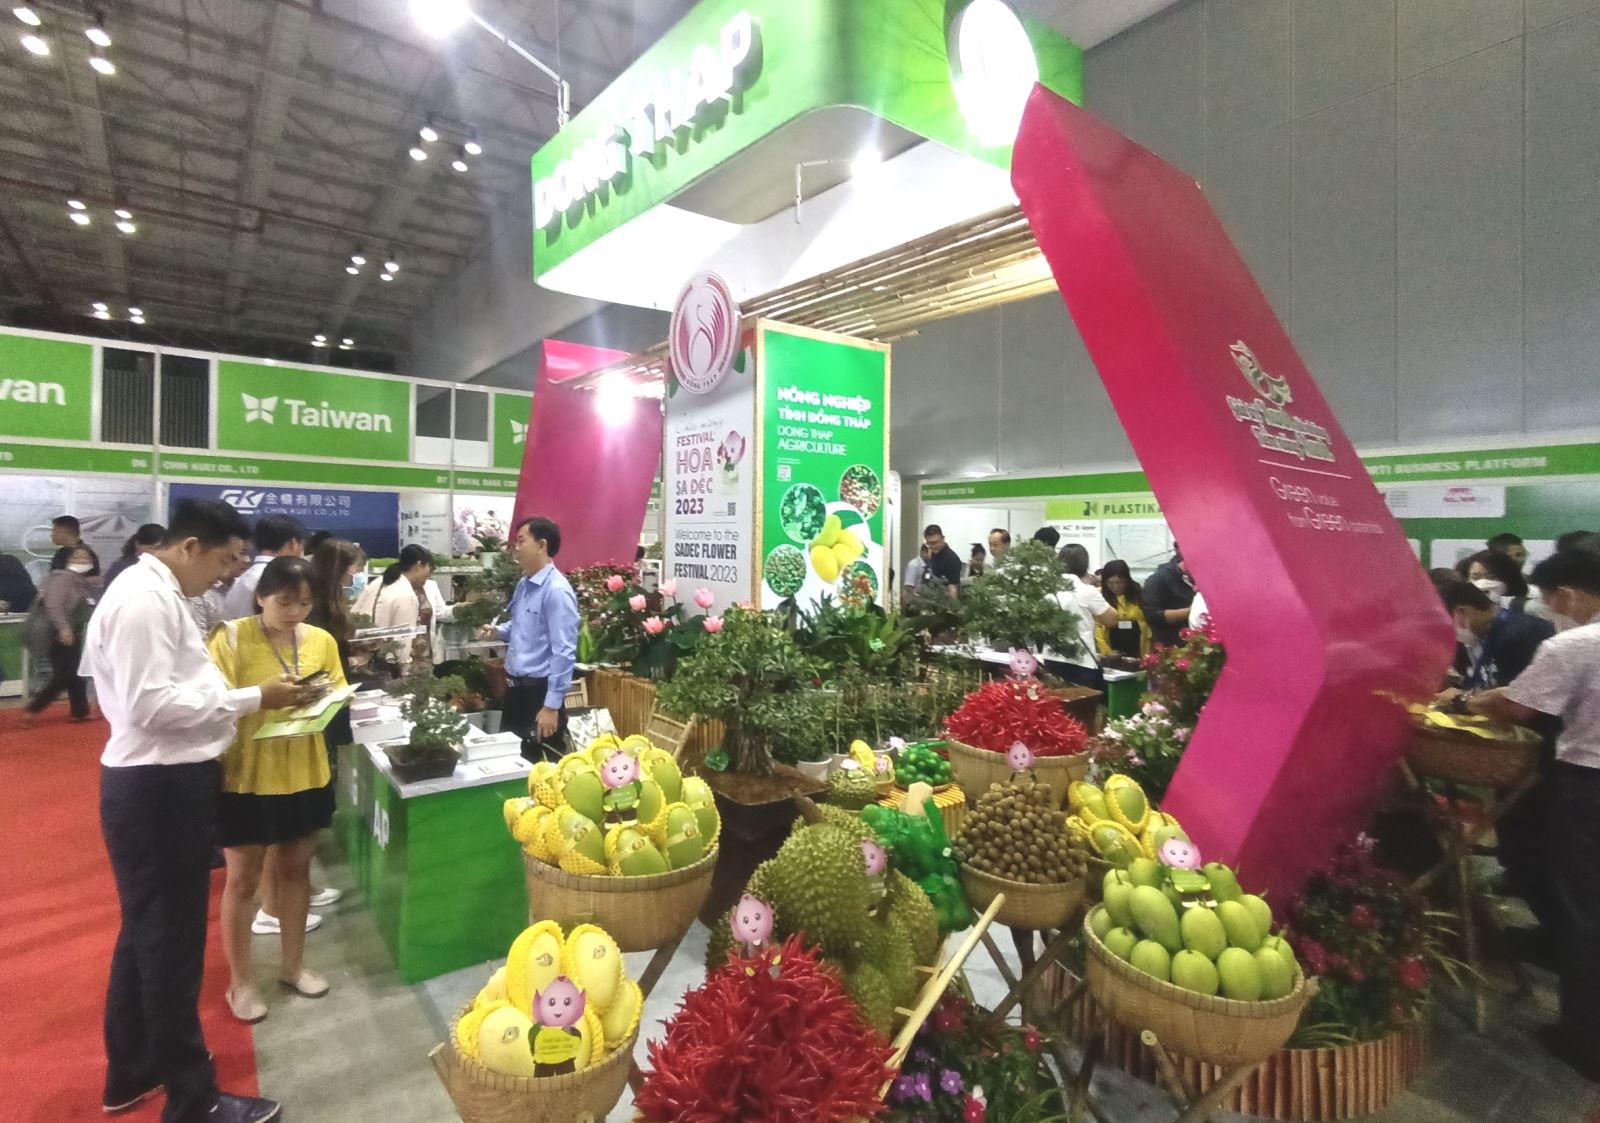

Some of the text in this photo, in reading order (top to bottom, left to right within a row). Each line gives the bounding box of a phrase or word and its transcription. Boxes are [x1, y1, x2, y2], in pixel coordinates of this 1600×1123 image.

[284, 398, 393, 433] Taiwan
[676, 431, 714, 447] FESTIVAL
[777, 425, 833, 440] DONG THAP
[777, 438, 847, 456] AGRICULTURE
[676, 447, 713, 474] HOA
[1395, 461, 1461, 474] BUSINESS
[1465, 456, 1547, 470] PLATFORM
[1269, 476, 1314, 503] Green
[675, 498, 704, 515] 2023
[1304, 507, 1348, 531] Green
[675, 528, 739, 541] Welcome to the
[675, 542, 737, 560] SADEC FLOWER
[674, 563, 738, 583] FESTIVAL 2023
